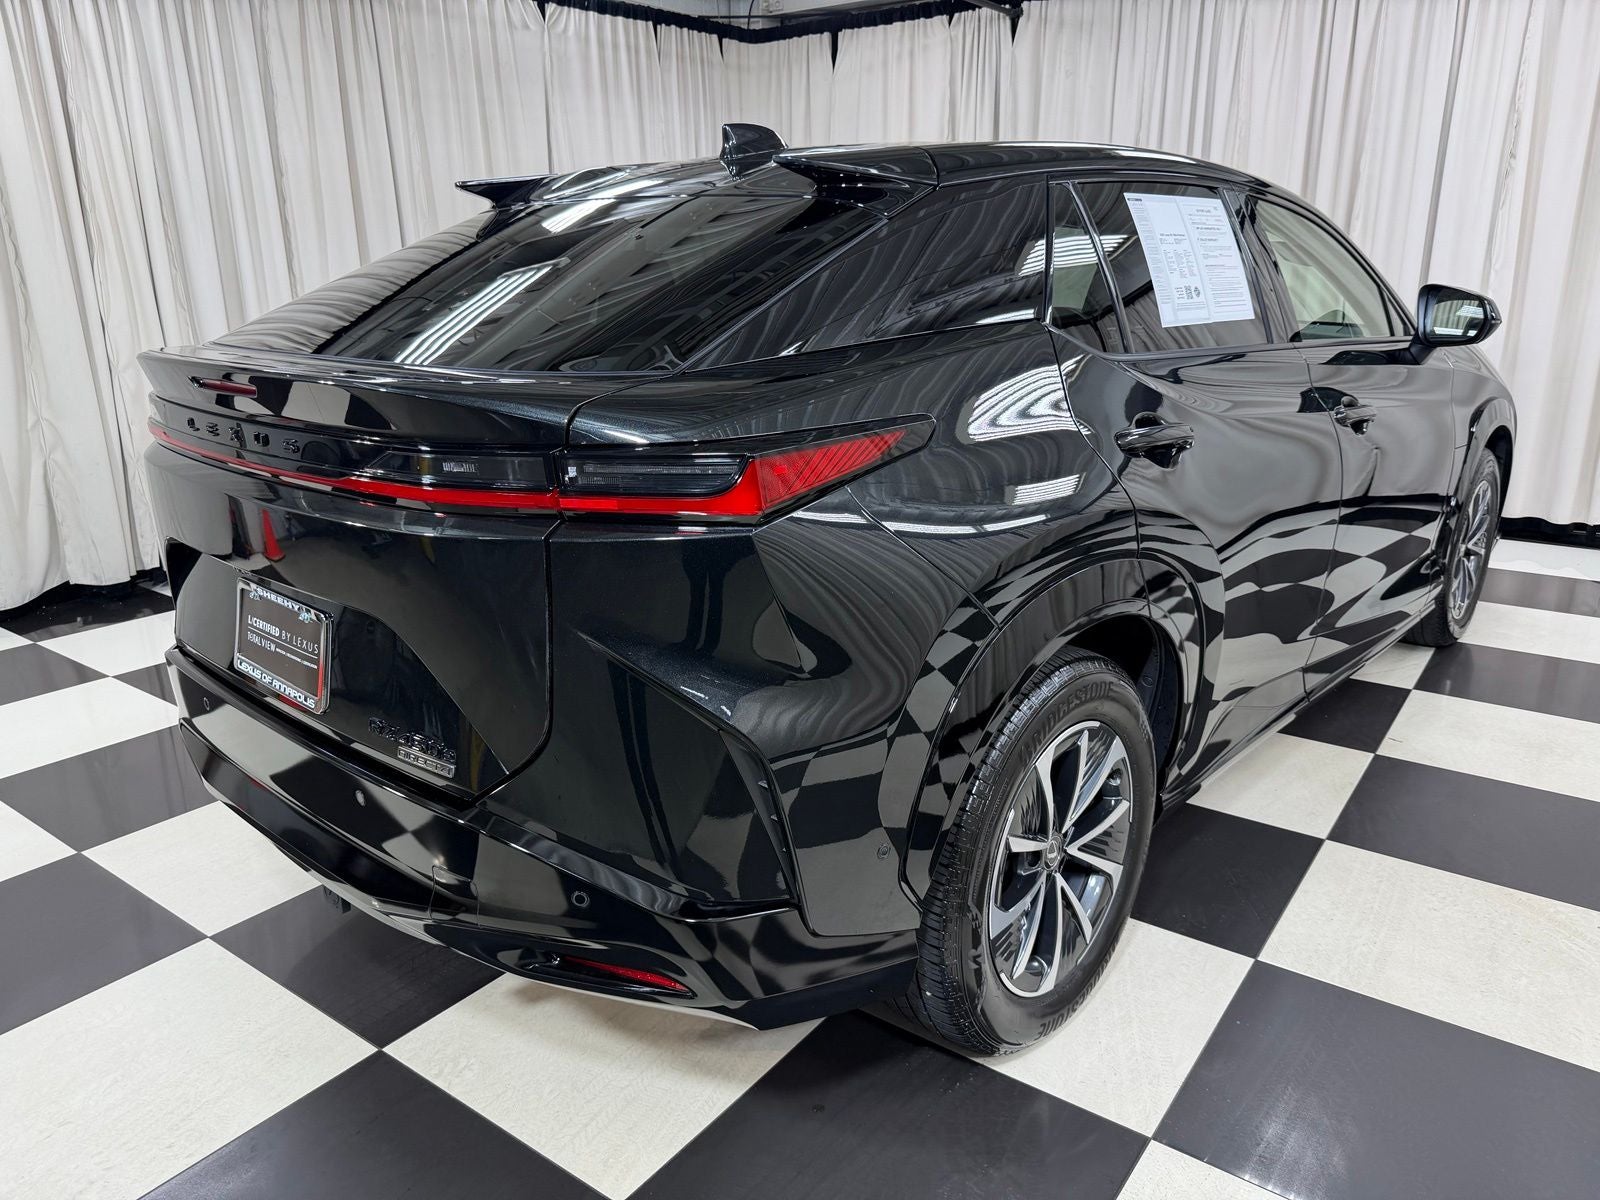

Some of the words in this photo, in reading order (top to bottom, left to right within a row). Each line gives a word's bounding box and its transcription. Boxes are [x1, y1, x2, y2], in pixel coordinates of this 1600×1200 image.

[256, 587, 300, 612] SHEEHY
[281, 630, 291, 642] BY
[293, 635, 319, 654] LEXUS
[237, 659, 262, 680] LEXUS
[262, 672, 273, 686] OF
[272, 679, 316, 709] ANNAPOLIS
